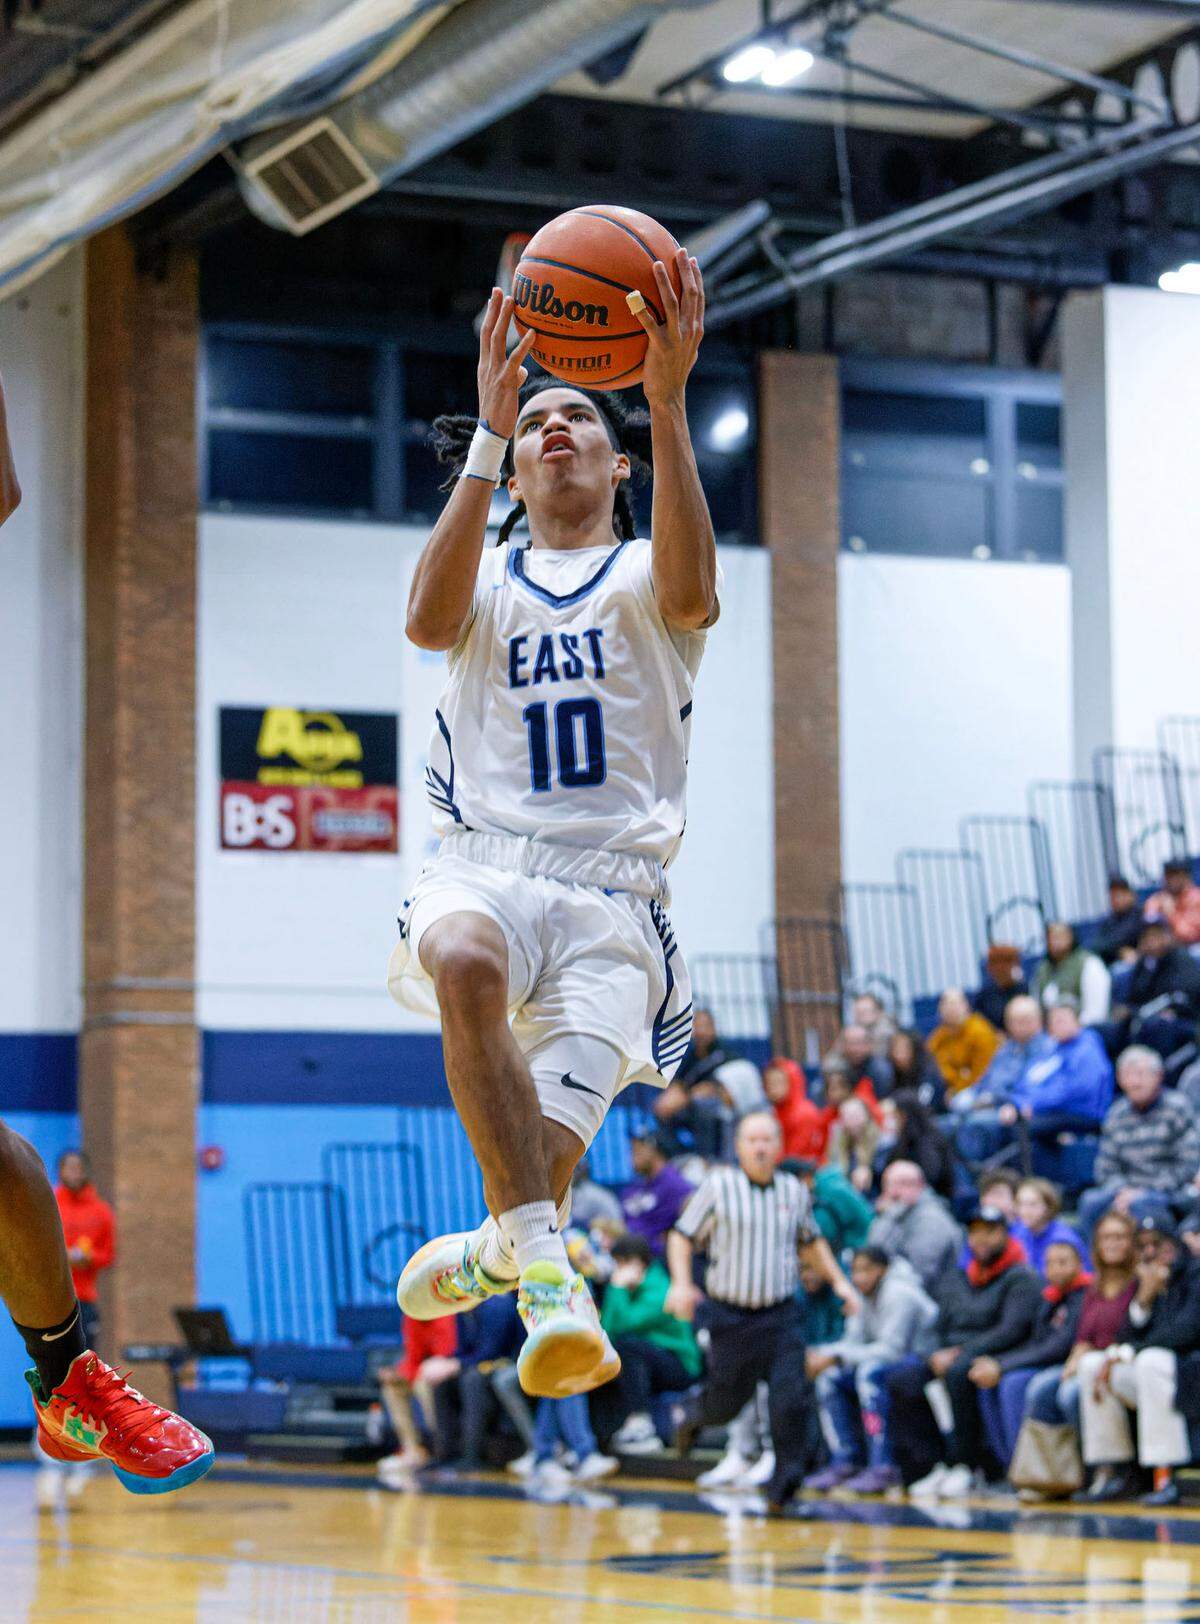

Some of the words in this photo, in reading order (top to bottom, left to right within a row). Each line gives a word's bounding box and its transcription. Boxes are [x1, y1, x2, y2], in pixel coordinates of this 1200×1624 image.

[514, 272, 609, 327] Wilson
[508, 627, 606, 689] EAST
[522, 696, 608, 794] 10
